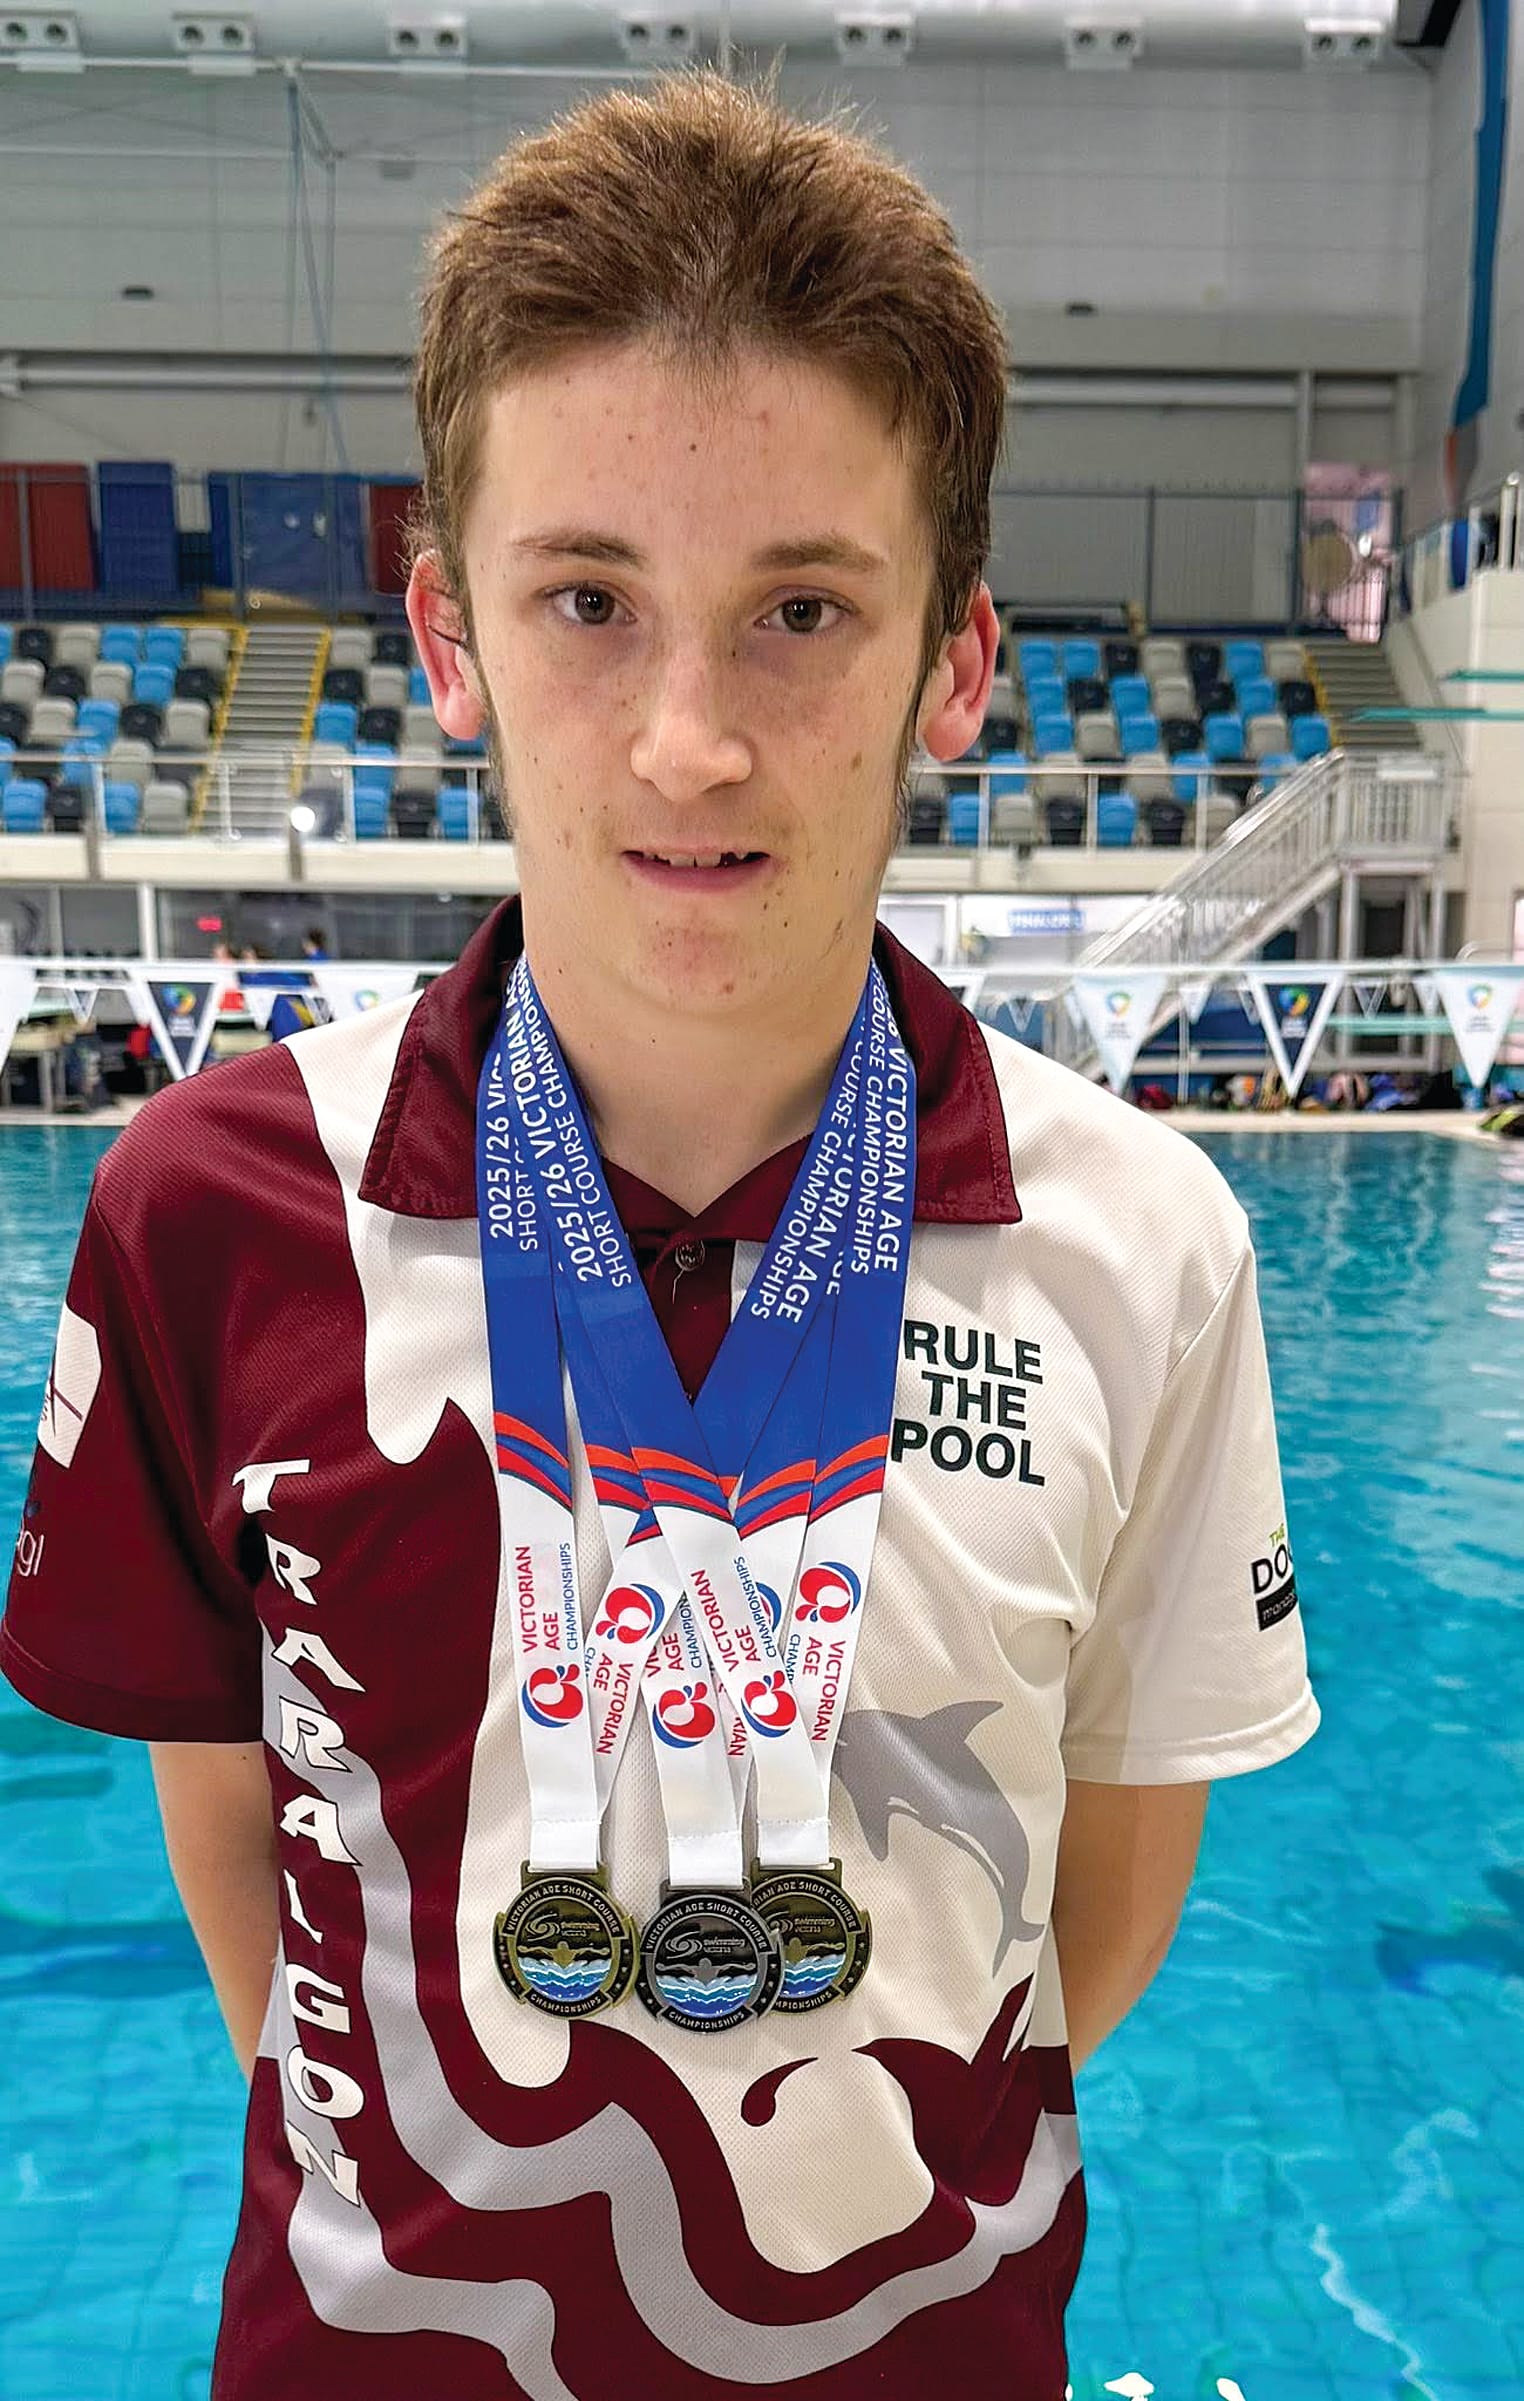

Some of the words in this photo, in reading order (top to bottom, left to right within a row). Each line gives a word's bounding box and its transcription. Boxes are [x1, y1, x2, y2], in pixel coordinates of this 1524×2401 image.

[868, 984, 886, 1071] COURSE
[507, 1010, 557, 1160] VICTORIAN
[882, 1047, 908, 1203] VICTORIAN
[486, 1117, 513, 1238] 2025/26
[555, 1112, 600, 1205] COURSE
[851, 1075, 883, 1274] CHAMPIONSHIPS
[516, 1170, 538, 1250] SHORT
[540, 1163, 603, 1282] 2025/26
[587, 1210, 632, 1288] SHORT
[751, 1131, 842, 1319] CHAMPIONSHIPS
[875, 1209, 903, 1272] AGE
[776, 1260, 818, 1323] AGE
[903, 1319, 1043, 1385] RULE
[921, 1370, 1027, 1431] THE
[890, 1418, 1045, 1487] POOL
[515, 1546, 538, 1653] VICTORIAN
[559, 1542, 579, 1651] CHAMPIONSHIPS
[733, 1556, 777, 1658] CHAMPIONSHIPS
[1250, 1543, 1293, 1595] DO
[542, 1611, 561, 1651] AGE
[662, 1632, 685, 1671] AGE
[691, 1569, 740, 1673] VICTORIAN
[735, 1625, 762, 1664] AGE
[802, 1636, 823, 1676] AGE
[593, 1652, 614, 1691] AGE
[596, 1663, 634, 1755] VICTORIAN
[812, 1640, 846, 1742] VICTORIAN
[506, 1890, 541, 1931] VICTORIAN
[645, 1908, 683, 1950] VICTORIAN
